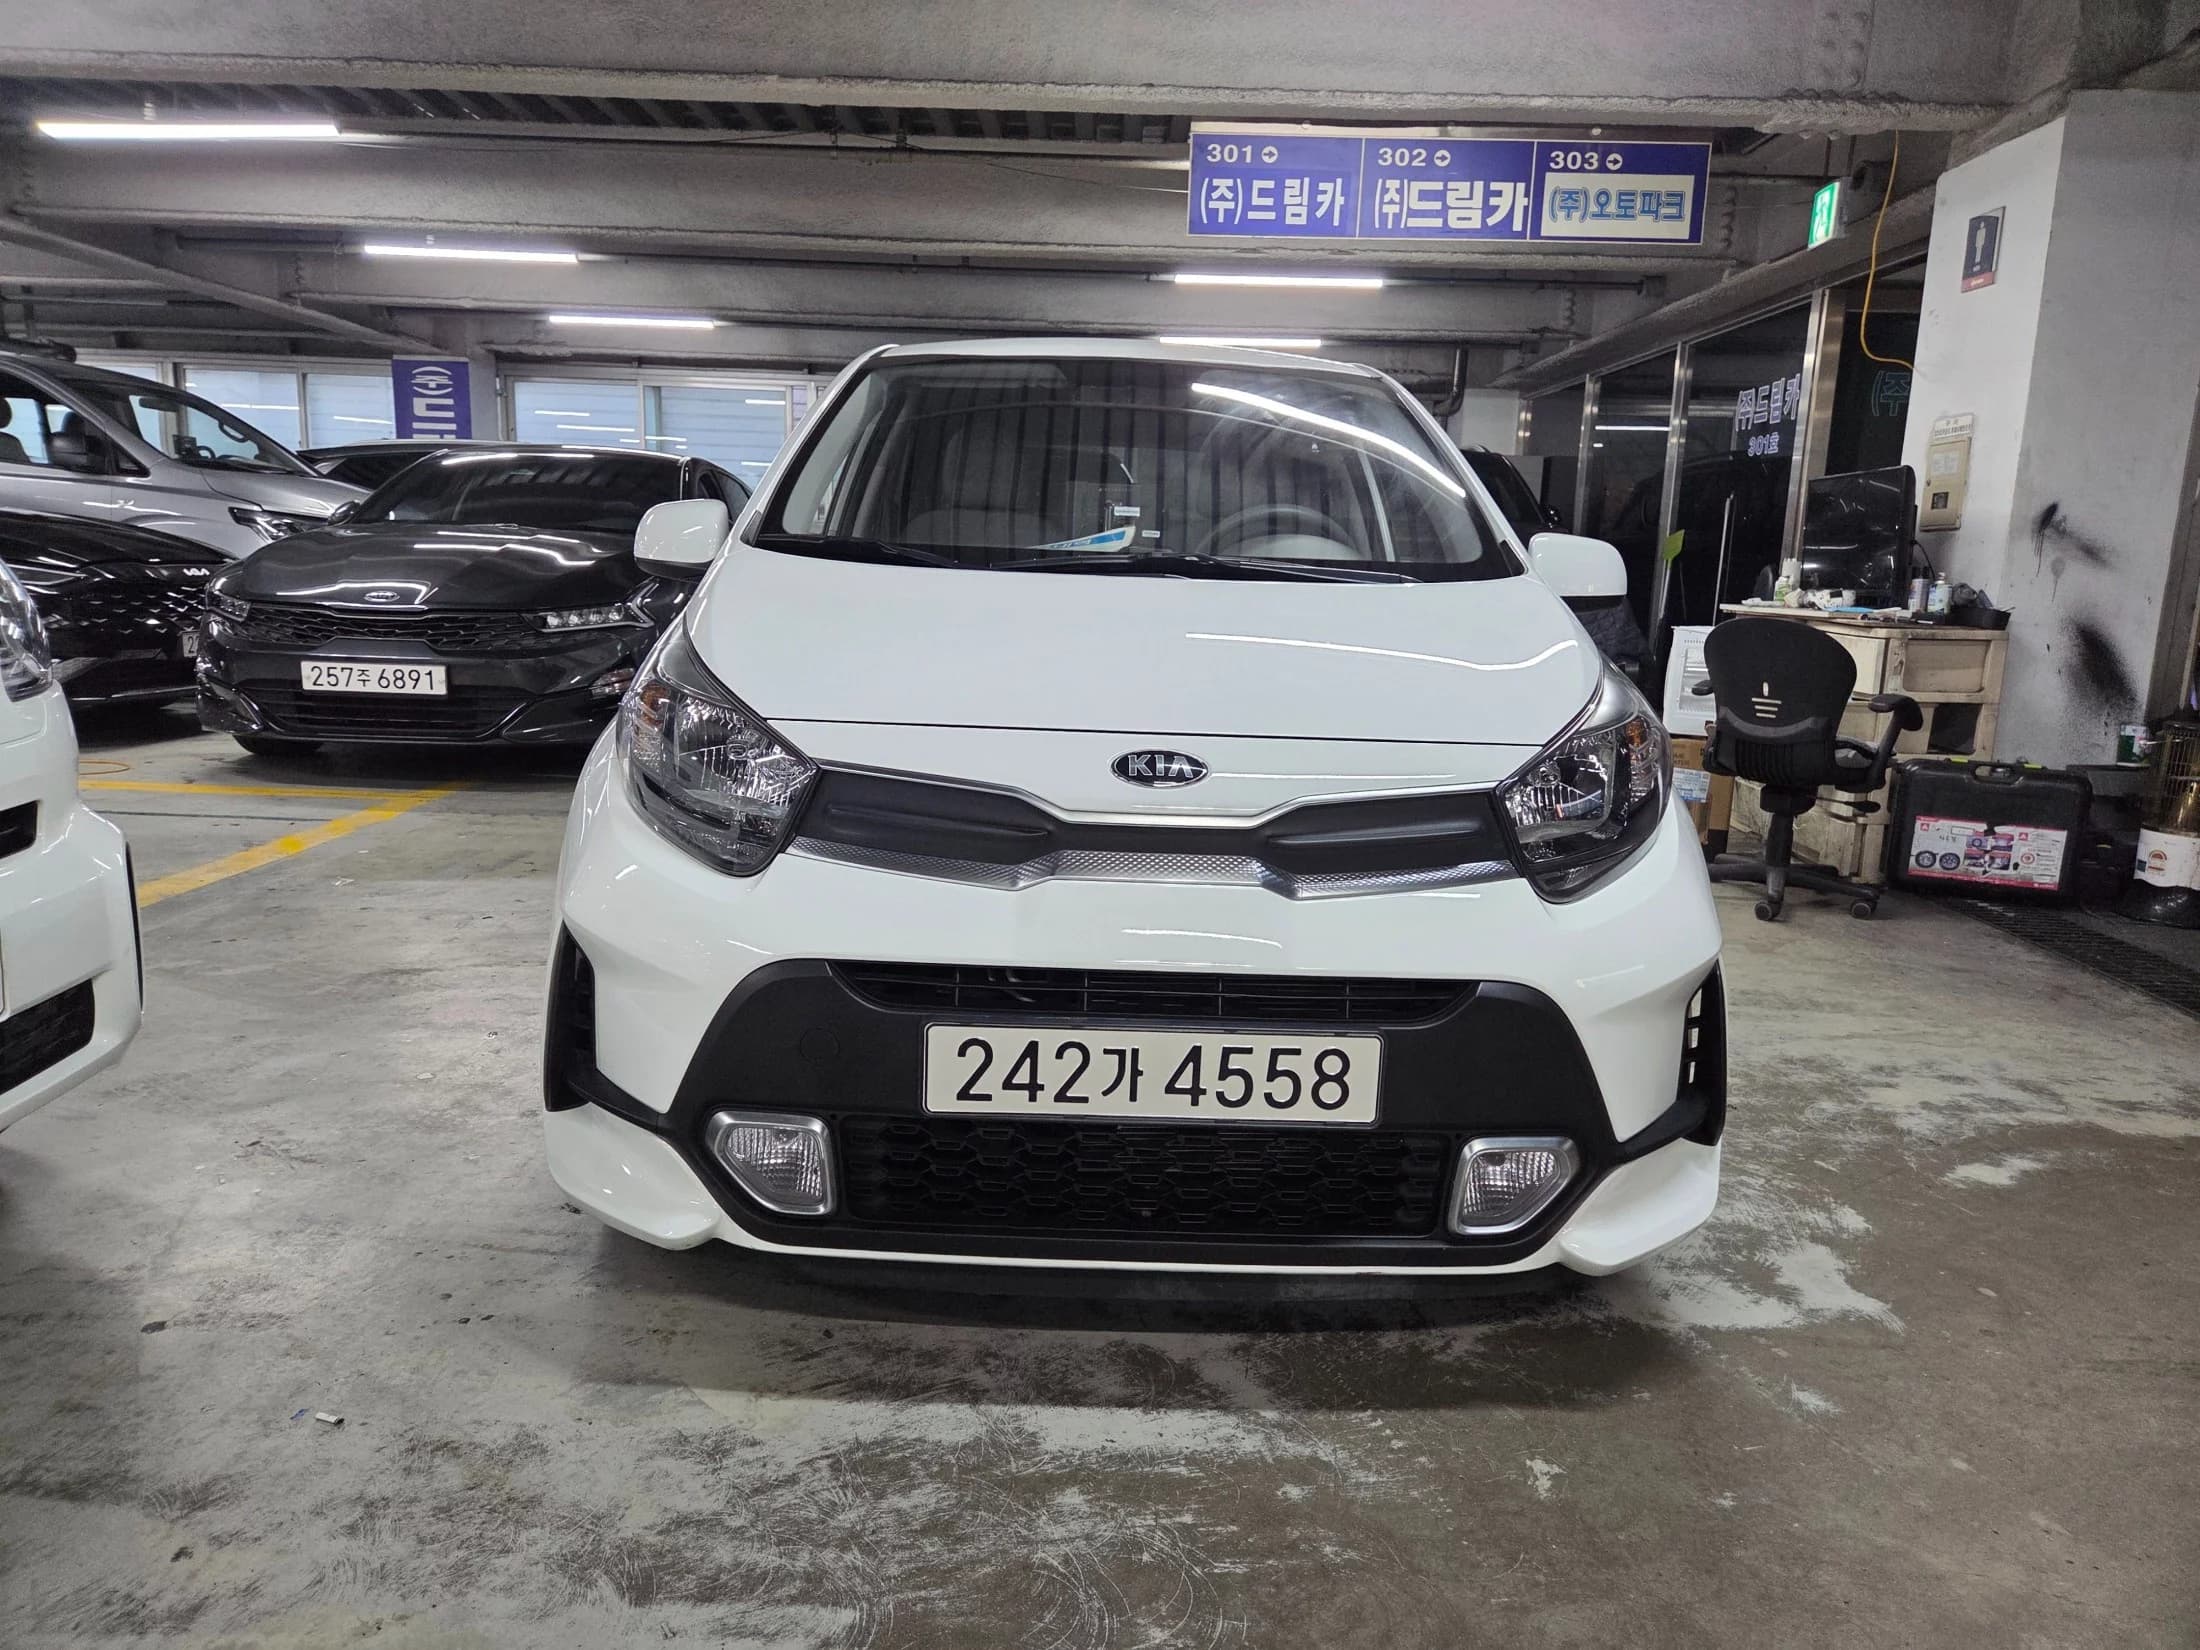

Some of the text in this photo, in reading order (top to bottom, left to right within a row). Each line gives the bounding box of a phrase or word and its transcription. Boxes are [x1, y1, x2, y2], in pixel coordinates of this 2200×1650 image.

[1206, 144, 1252, 163] 301
[1378, 147, 1427, 166] 302
[1550, 151, 1599, 170] 303
[1375, 178, 1529, 231] (주)드림카
[1549, 186, 1686, 223] (주)오토파크
[1735, 373, 1800, 432] (주)드림카
[1747, 432, 1779, 457] 301호
[311, 665, 434, 691] 257주 6891
[1127, 754, 1194, 778] KIA
[956, 1037, 1351, 1111] 242가 4558
